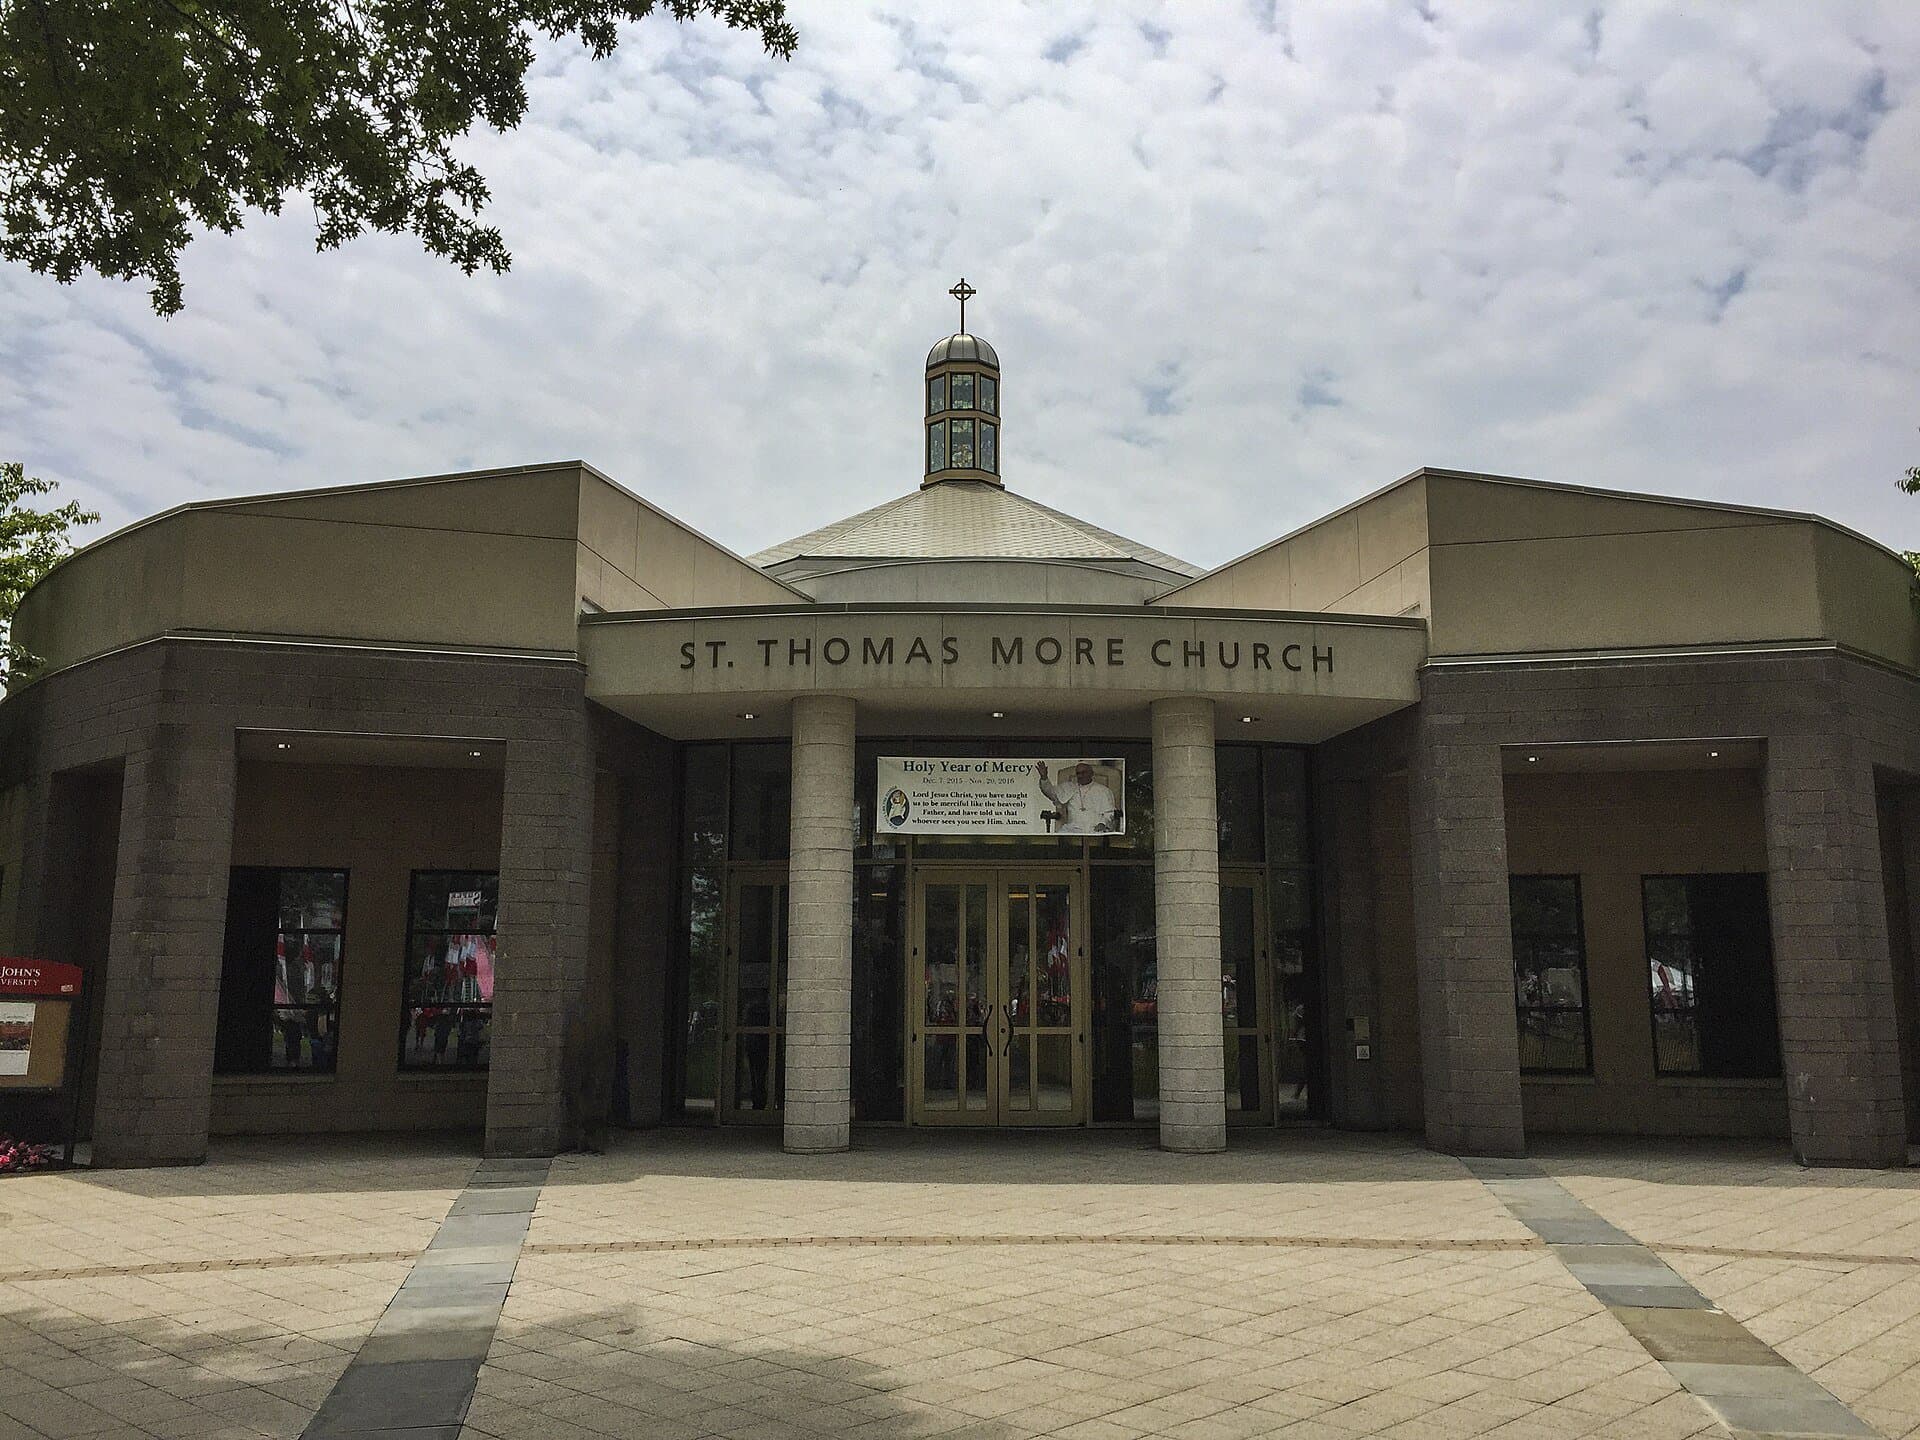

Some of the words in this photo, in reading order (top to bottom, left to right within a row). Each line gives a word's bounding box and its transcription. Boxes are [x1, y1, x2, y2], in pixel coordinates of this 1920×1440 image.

[680, 640, 734, 669] ST.
[757, 636, 959, 667] THOMAS
[991, 636, 1124, 666] MORE
[1151, 638, 1333, 673] CHURCH
[903, 760, 935, 775] Holy
[940, 761, 971, 772] Year
[975, 760, 989, 772] of
[992, 761, 1033, 776] Mercy
[930, 791, 949, 799] Jesus
[950, 791, 973, 799] Christ,
[1006, 791, 1028, 800] taught
[997, 800, 1026, 809] heavenly
[957, 819, 970, 827] you
[0, 966, 41, 978] JOHN'S
